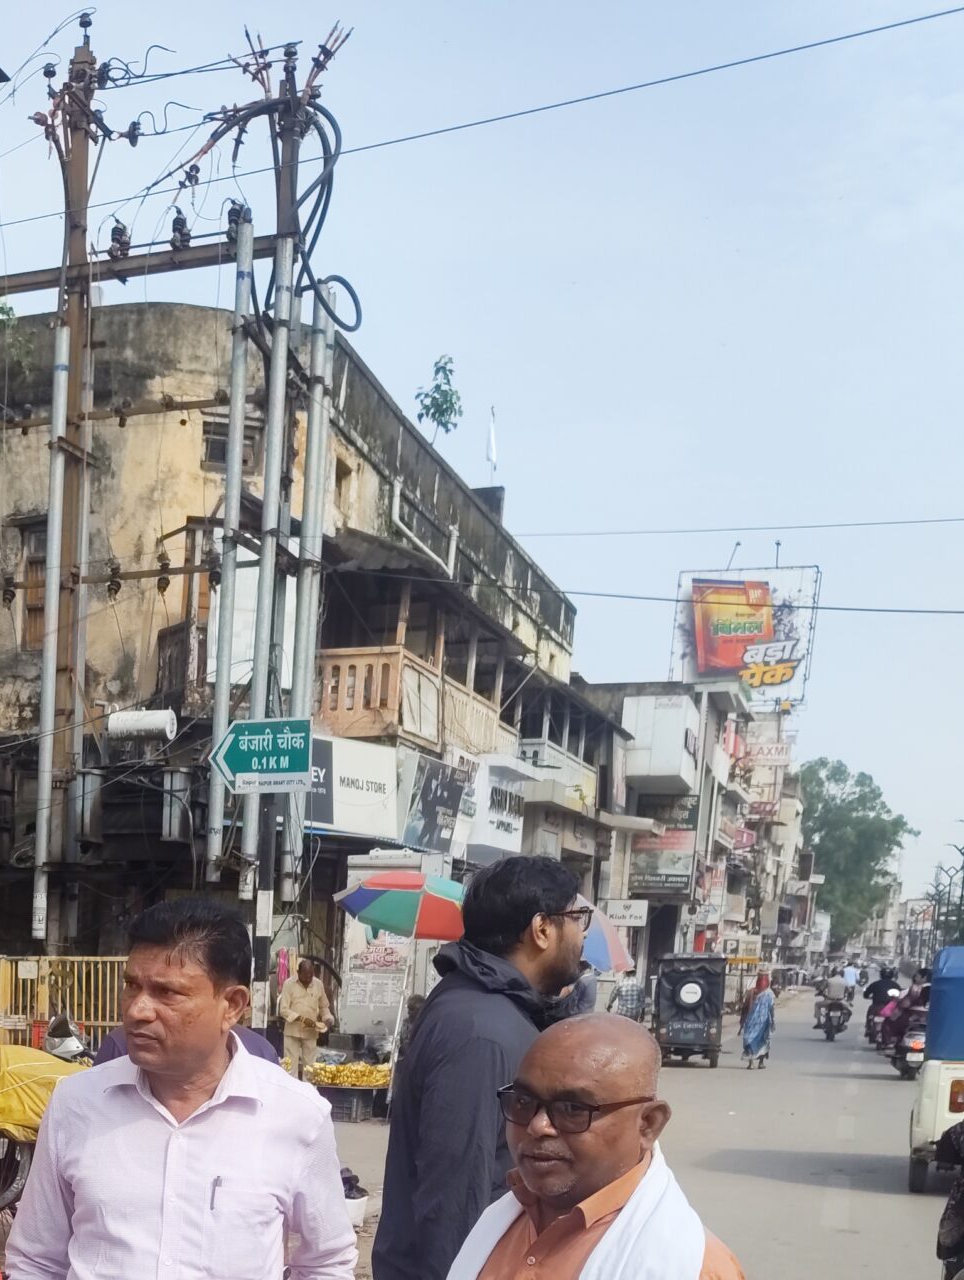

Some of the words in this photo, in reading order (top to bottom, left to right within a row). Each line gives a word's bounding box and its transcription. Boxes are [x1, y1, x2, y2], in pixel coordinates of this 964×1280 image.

[742, 640, 799, 666] बड़ा
[738, 661, 798, 688] पैक
[238, 728, 274, 752] बंजारी
[276, 726, 306, 750] चौक
[748, 745, 788, 757] LAXMI
[311, 766, 326, 783] EY
[339, 775, 364, 791] MANOJ
[365, 780, 387, 794] STORE
